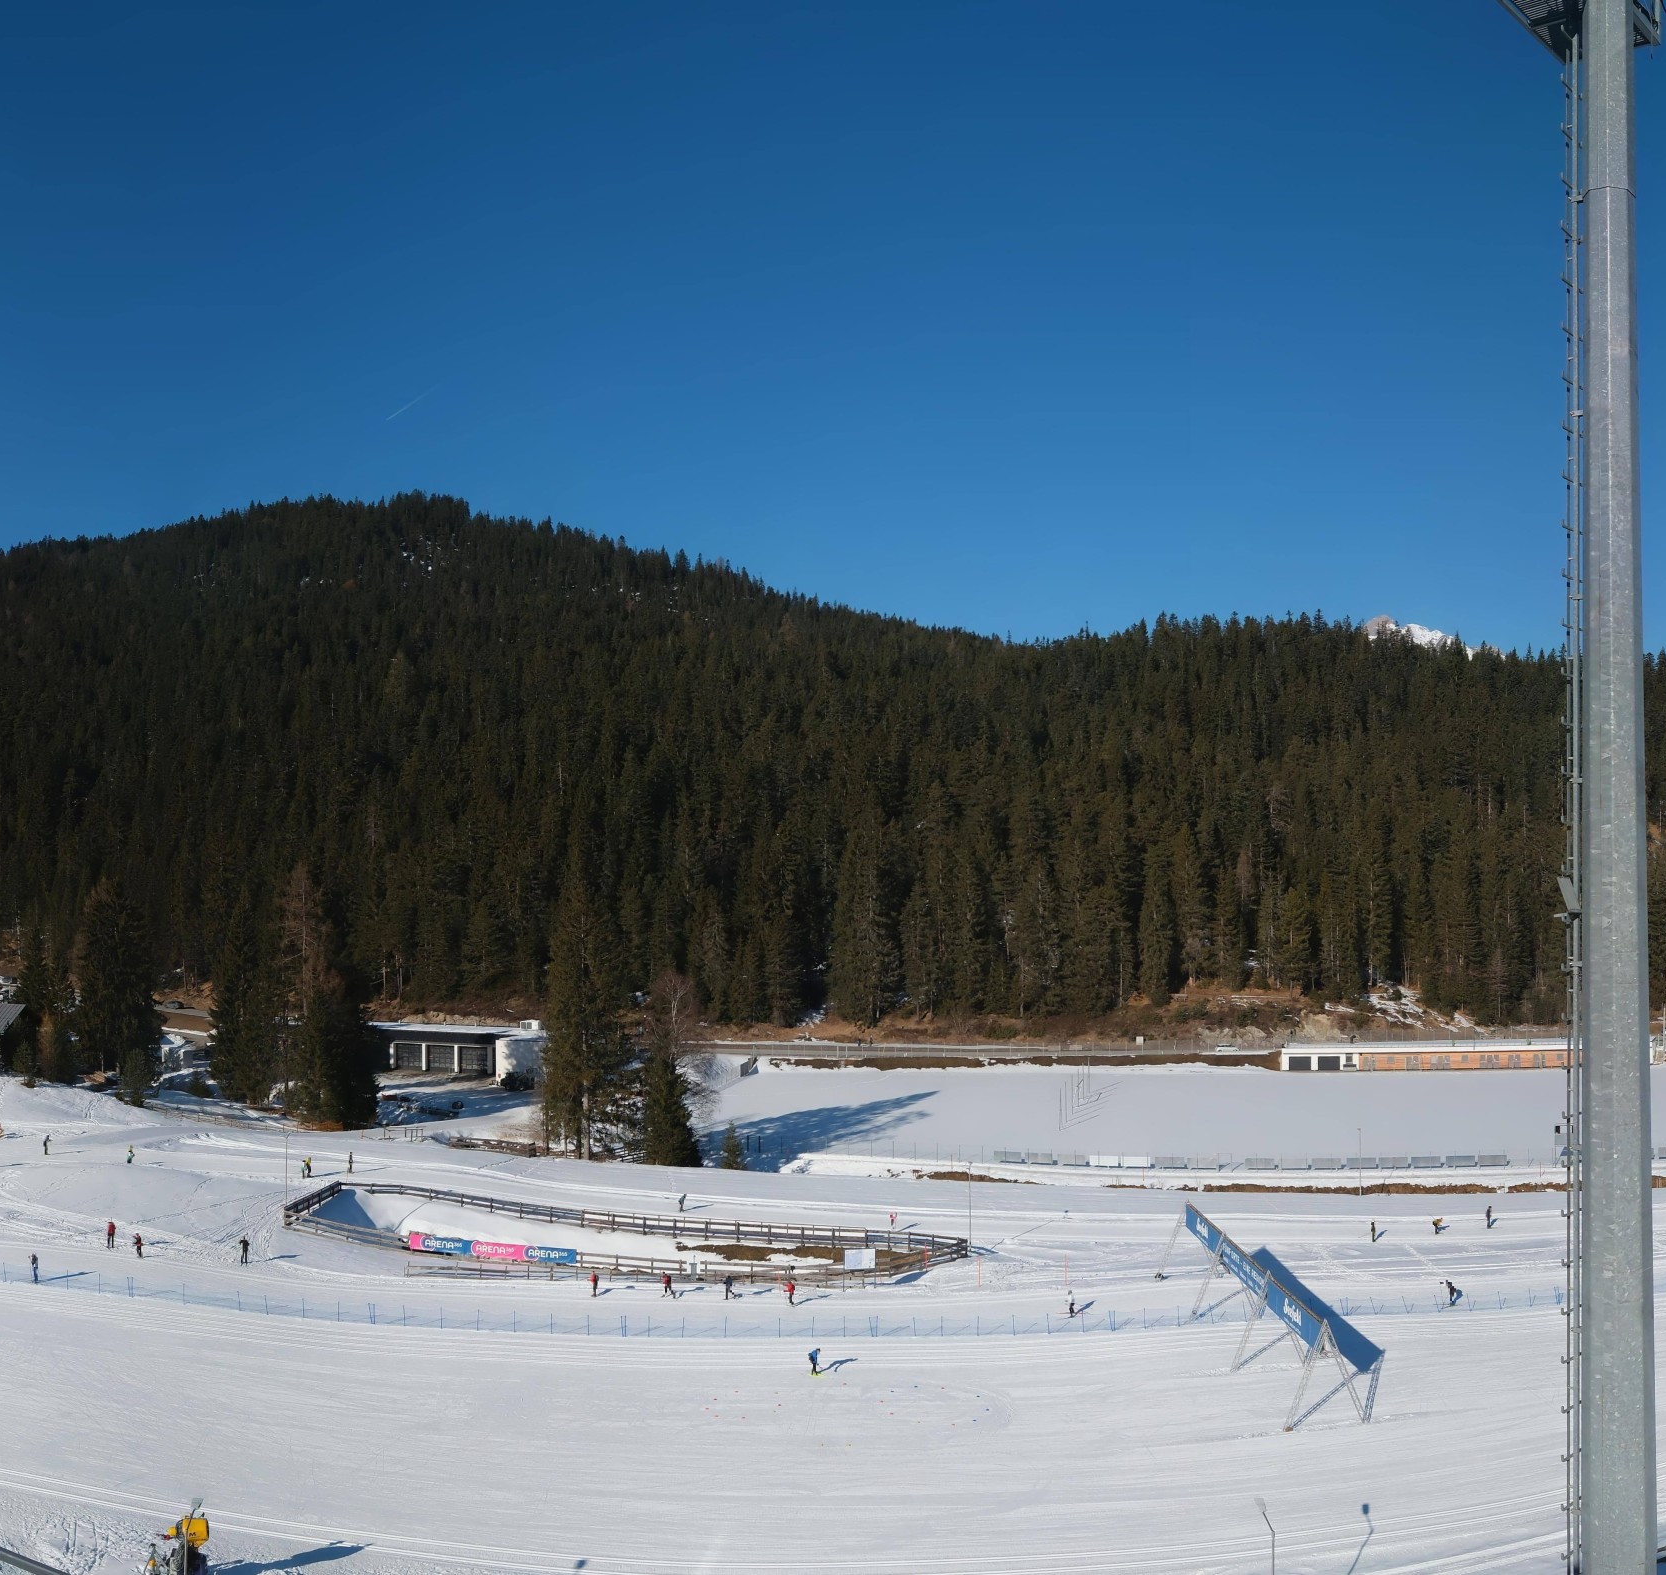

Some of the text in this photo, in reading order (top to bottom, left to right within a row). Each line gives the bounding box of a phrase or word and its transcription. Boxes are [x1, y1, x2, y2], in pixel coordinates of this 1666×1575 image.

[424, 1239, 454, 1250] ARENA
[476, 1244, 506, 1254] ARENA
[528, 1249, 558, 1259] ARENA
[1283, 1297, 1302, 1326] Seefeld
